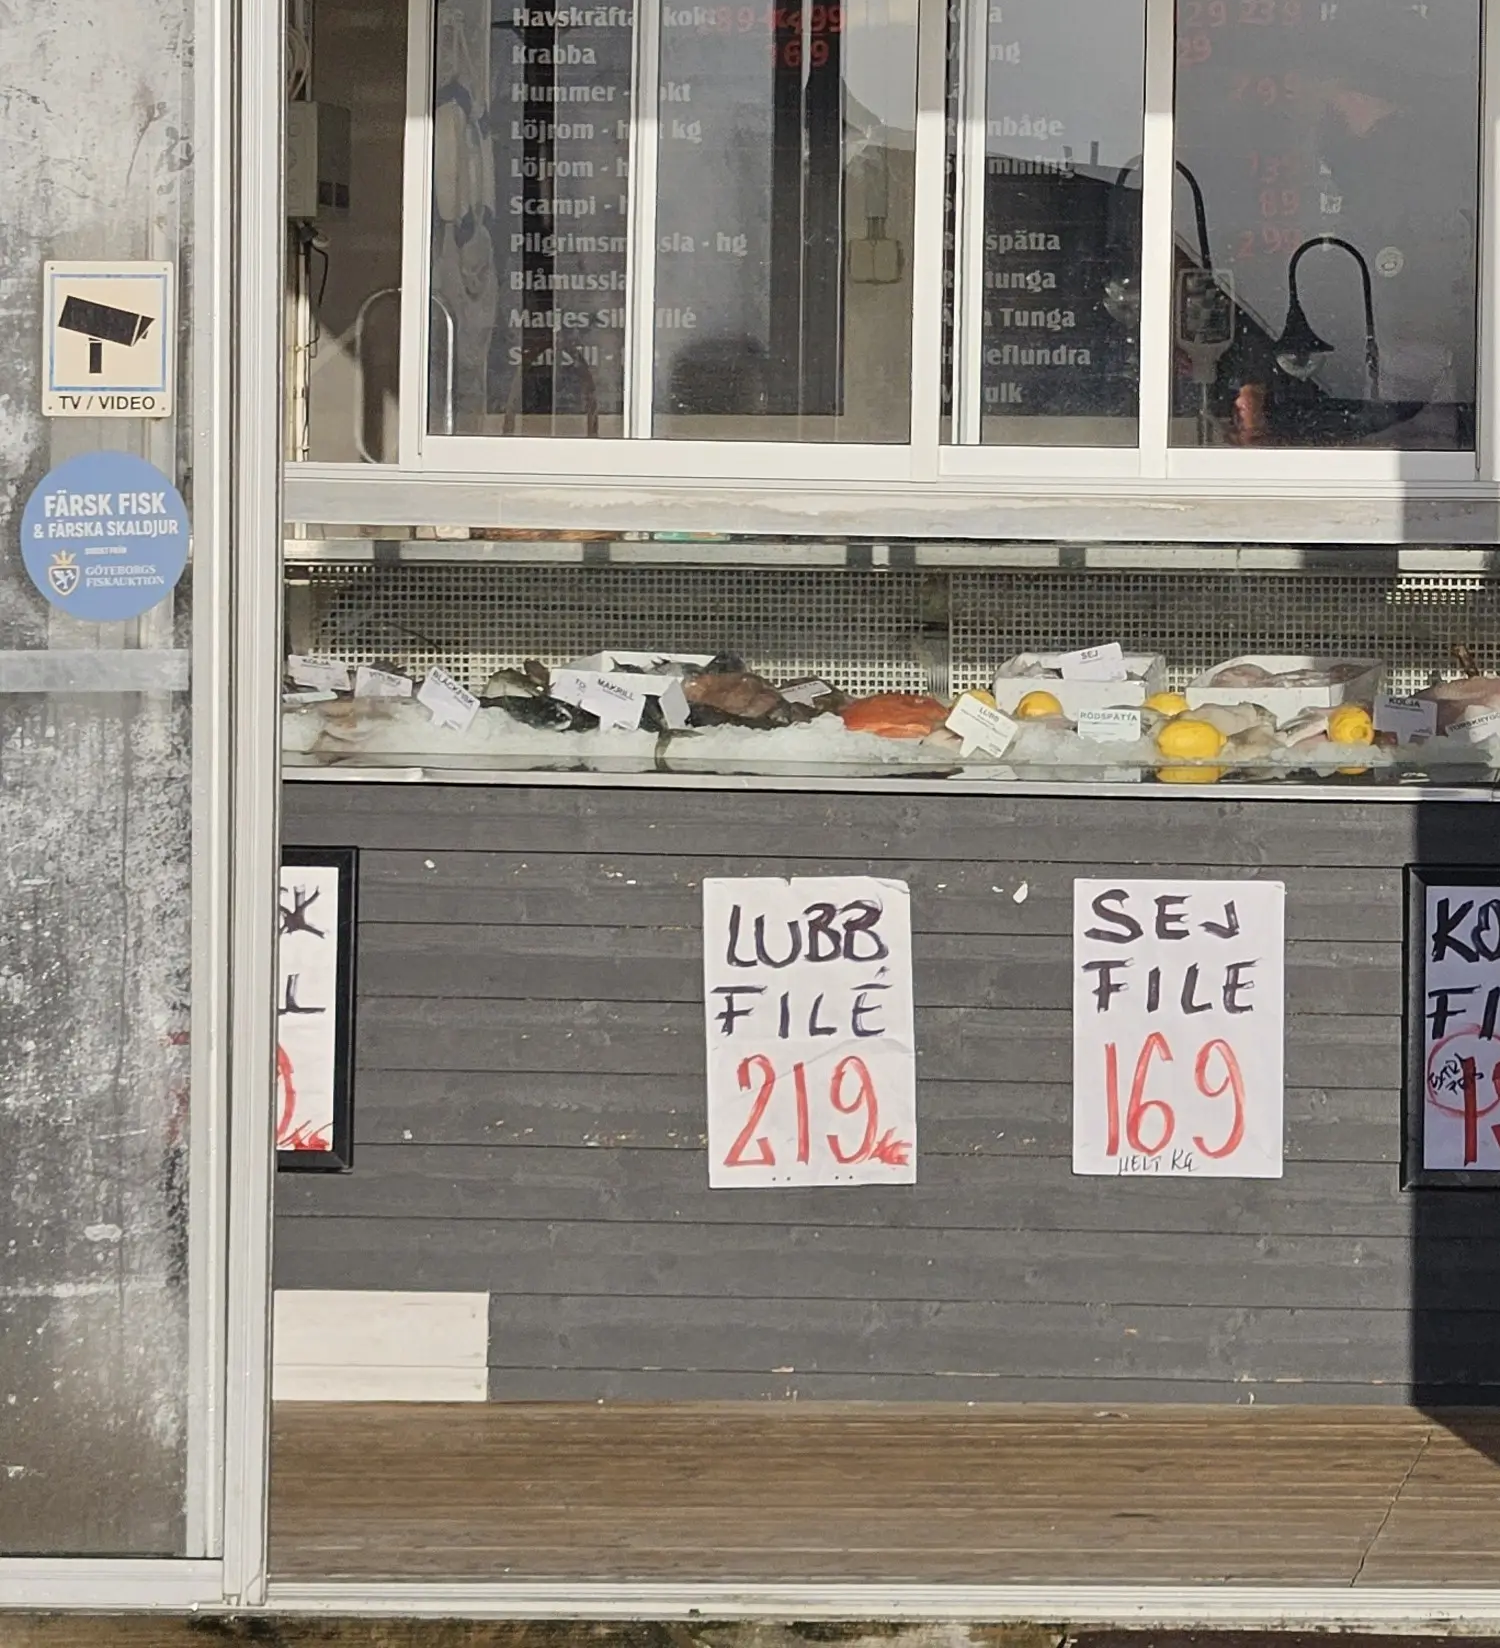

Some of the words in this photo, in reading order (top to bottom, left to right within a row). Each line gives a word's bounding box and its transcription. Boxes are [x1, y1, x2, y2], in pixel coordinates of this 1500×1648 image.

[512, 44, 597, 65] Krabba
[511, 82, 616, 102] Hummer
[510, 118, 595, 144] Löjrom
[671, 119, 703, 144] kg
[510, 156, 593, 181] Löjrom
[509, 196, 597, 218] Scampi
[716, 232, 748, 257] hg
[508, 308, 589, 333] Matjes
[1000, 307, 1076, 331] Tunga
[58, 395, 82, 411] TV
[99, 395, 156, 411] VIDEO
[44, 489, 114, 518] FÄRSK
[118, 491, 167, 515] FISK
[33, 523, 45, 539] &
[48, 519, 104, 539] FÄRSKA
[106, 519, 179, 538] SKALDJUR
[1083, 888, 1240, 945] SEJ
[724, 899, 890, 969] LUBB
[1104, 1031, 1247, 1160] 169
[724, 1053, 880, 1168] 219
